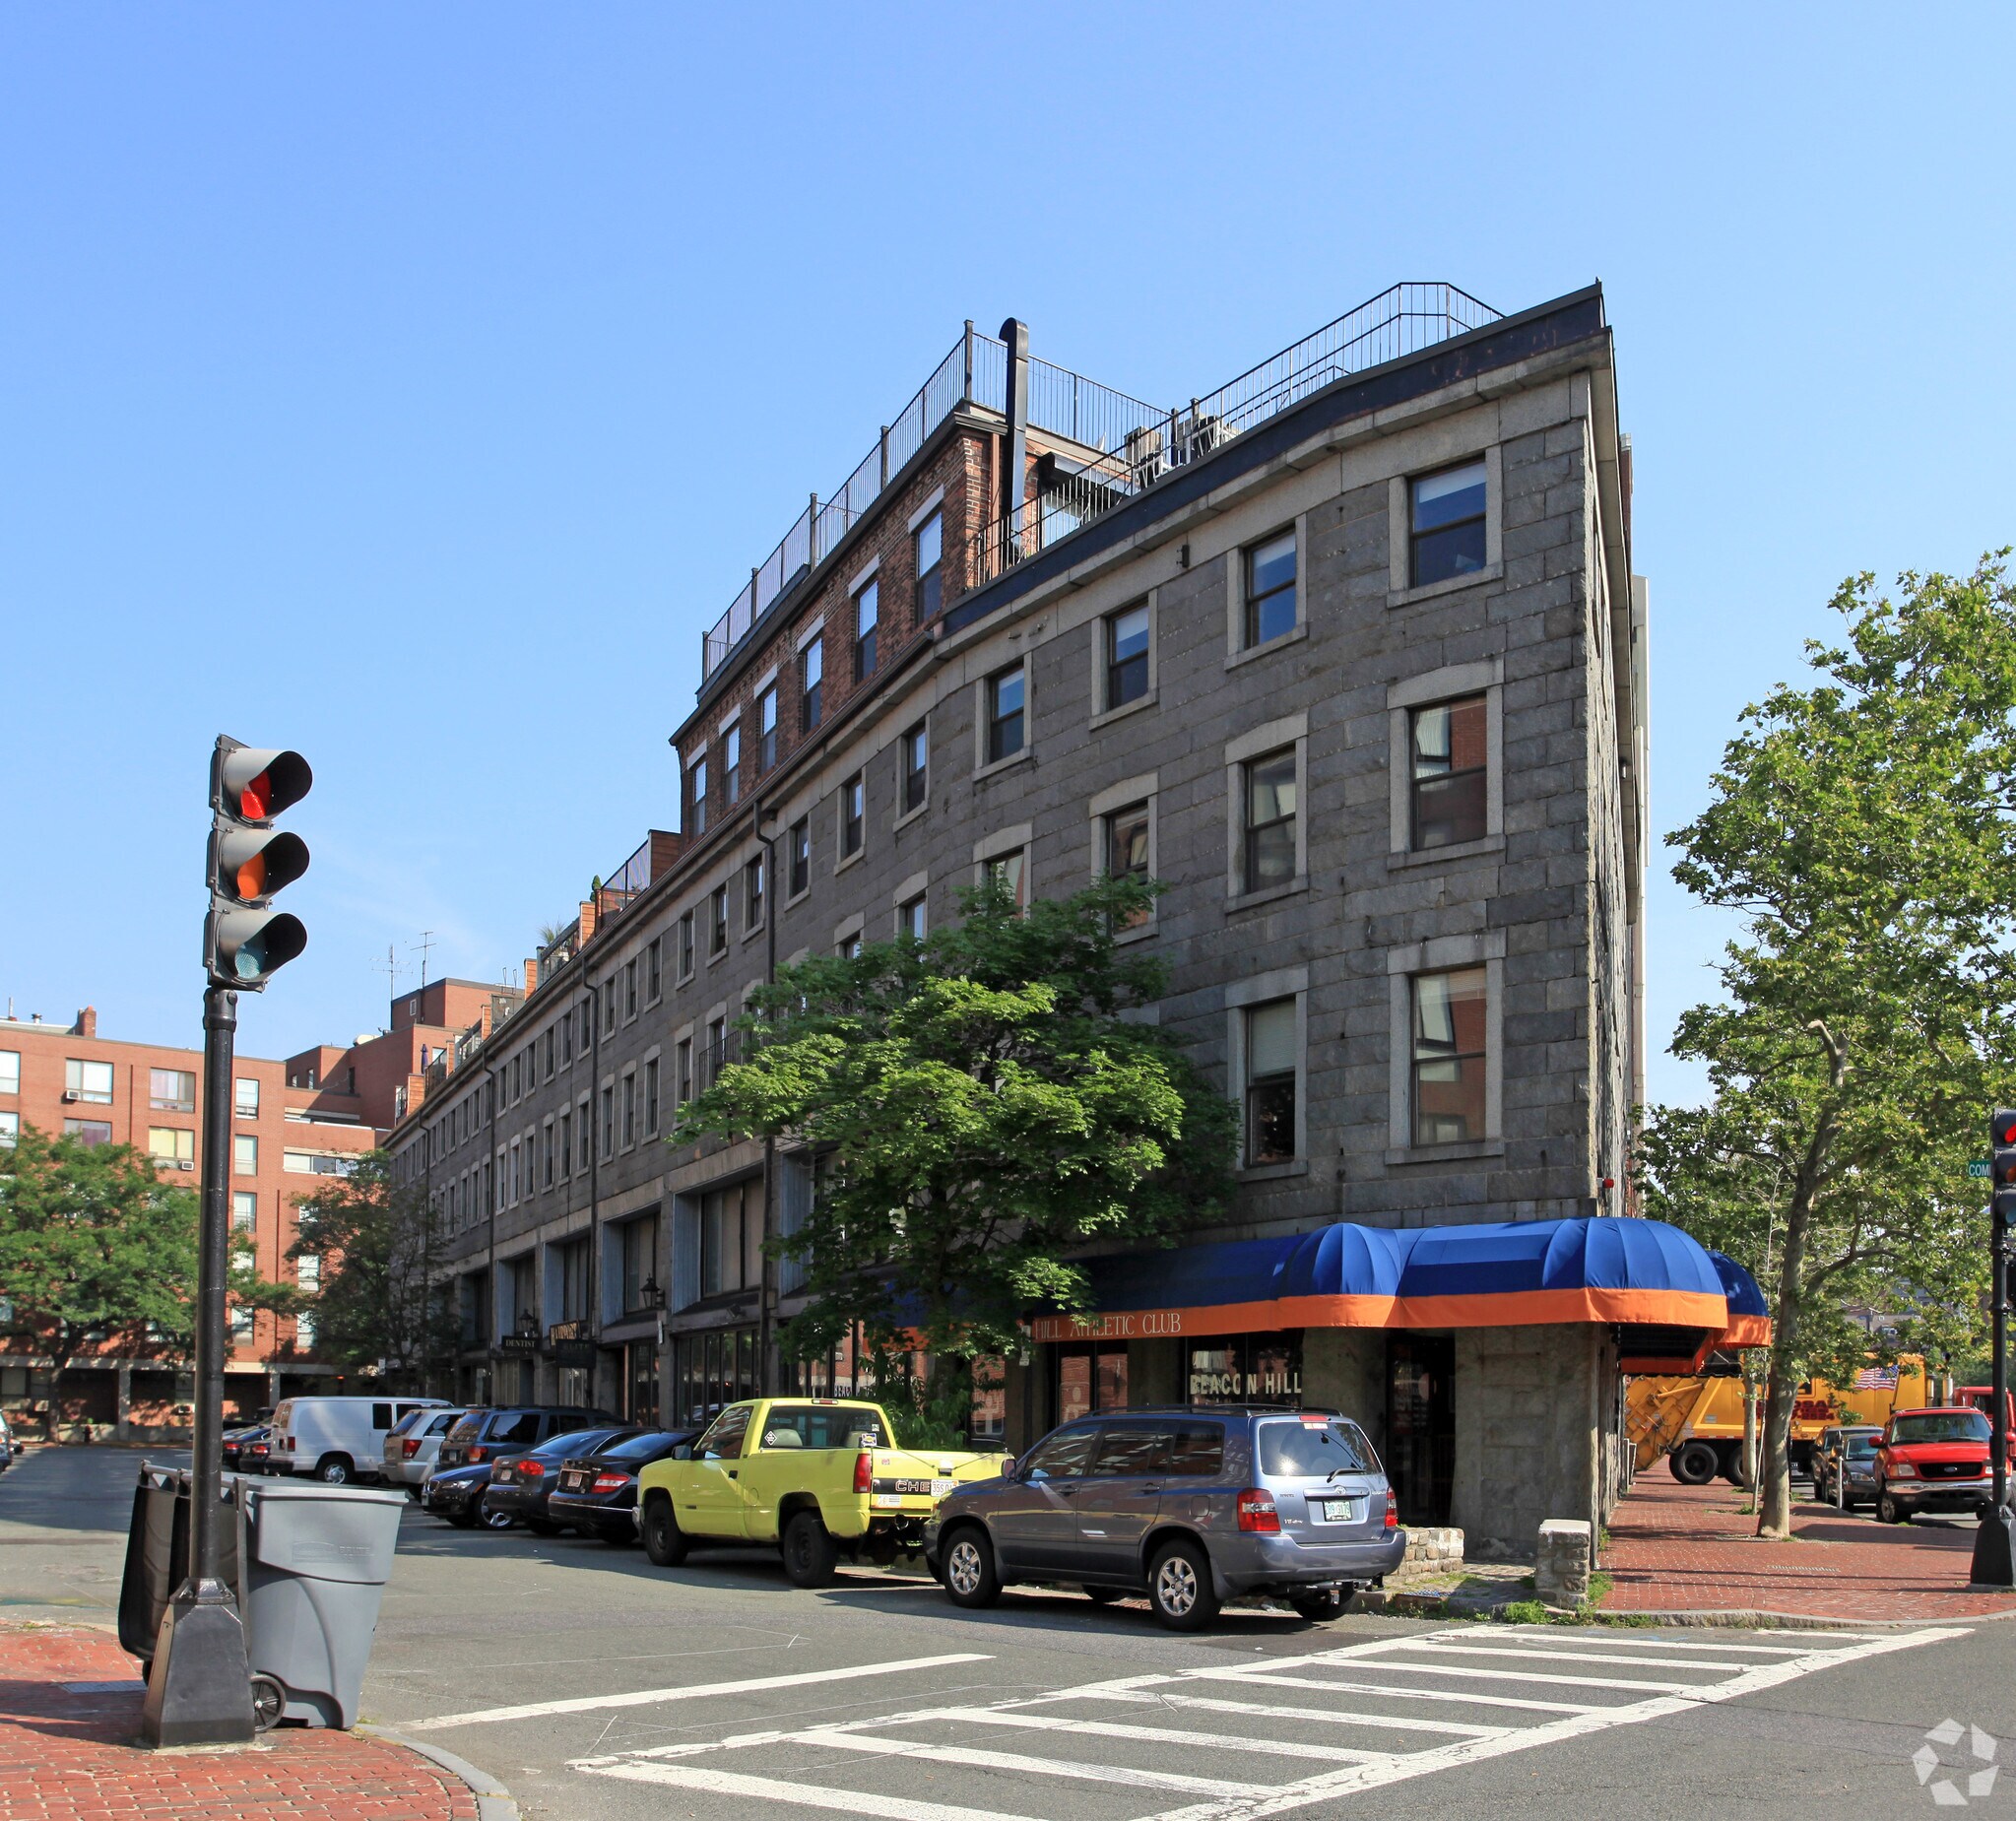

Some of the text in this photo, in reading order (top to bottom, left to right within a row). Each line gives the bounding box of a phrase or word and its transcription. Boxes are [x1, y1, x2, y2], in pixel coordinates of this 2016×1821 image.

[1035, 1320, 1062, 1339] HILL
[1142, 1313, 1181, 1333] CLUB
[505, 1339, 536, 1348] DENTIST
[1190, 1372, 1301, 1395] BEACON HILL
[895, 1481, 931, 1491] CHE
